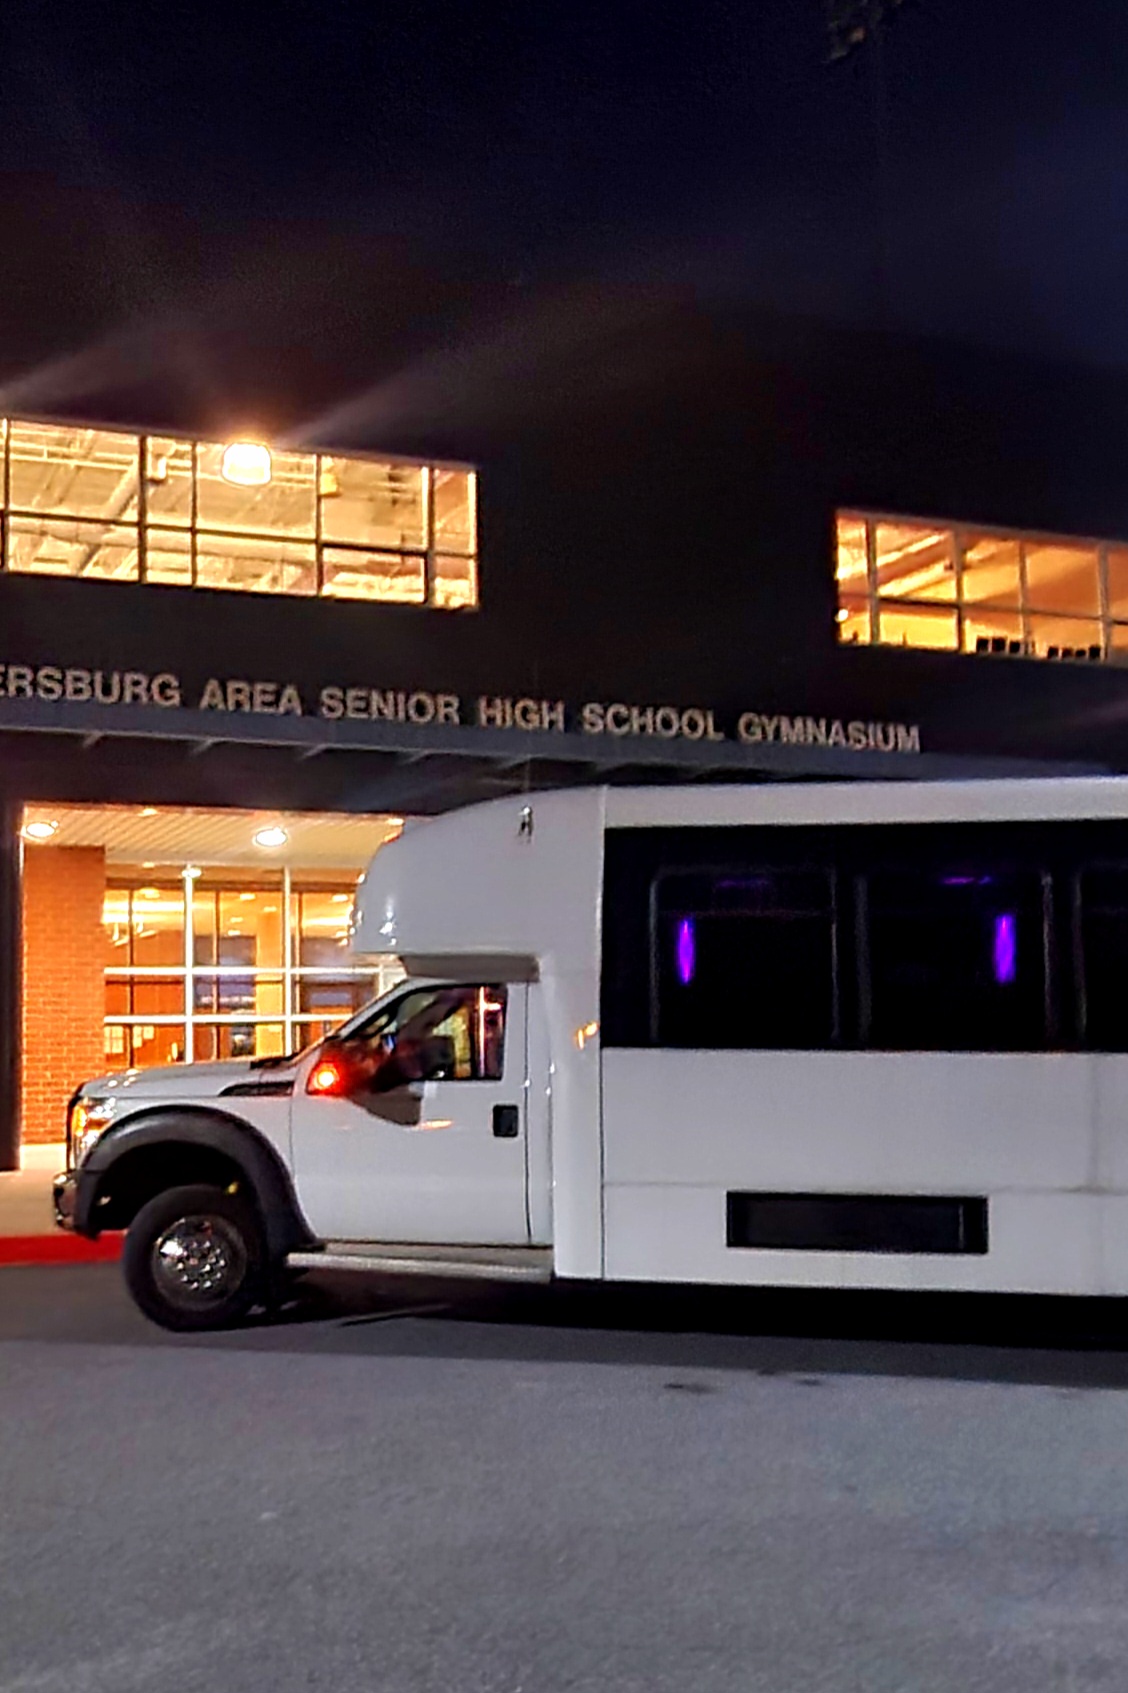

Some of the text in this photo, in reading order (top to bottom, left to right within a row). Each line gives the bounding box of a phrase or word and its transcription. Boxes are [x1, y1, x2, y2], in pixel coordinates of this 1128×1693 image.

[0, 664, 921, 753] RSBURG AREA SENIOR HIGH SCHOOL GYMNASIUM
